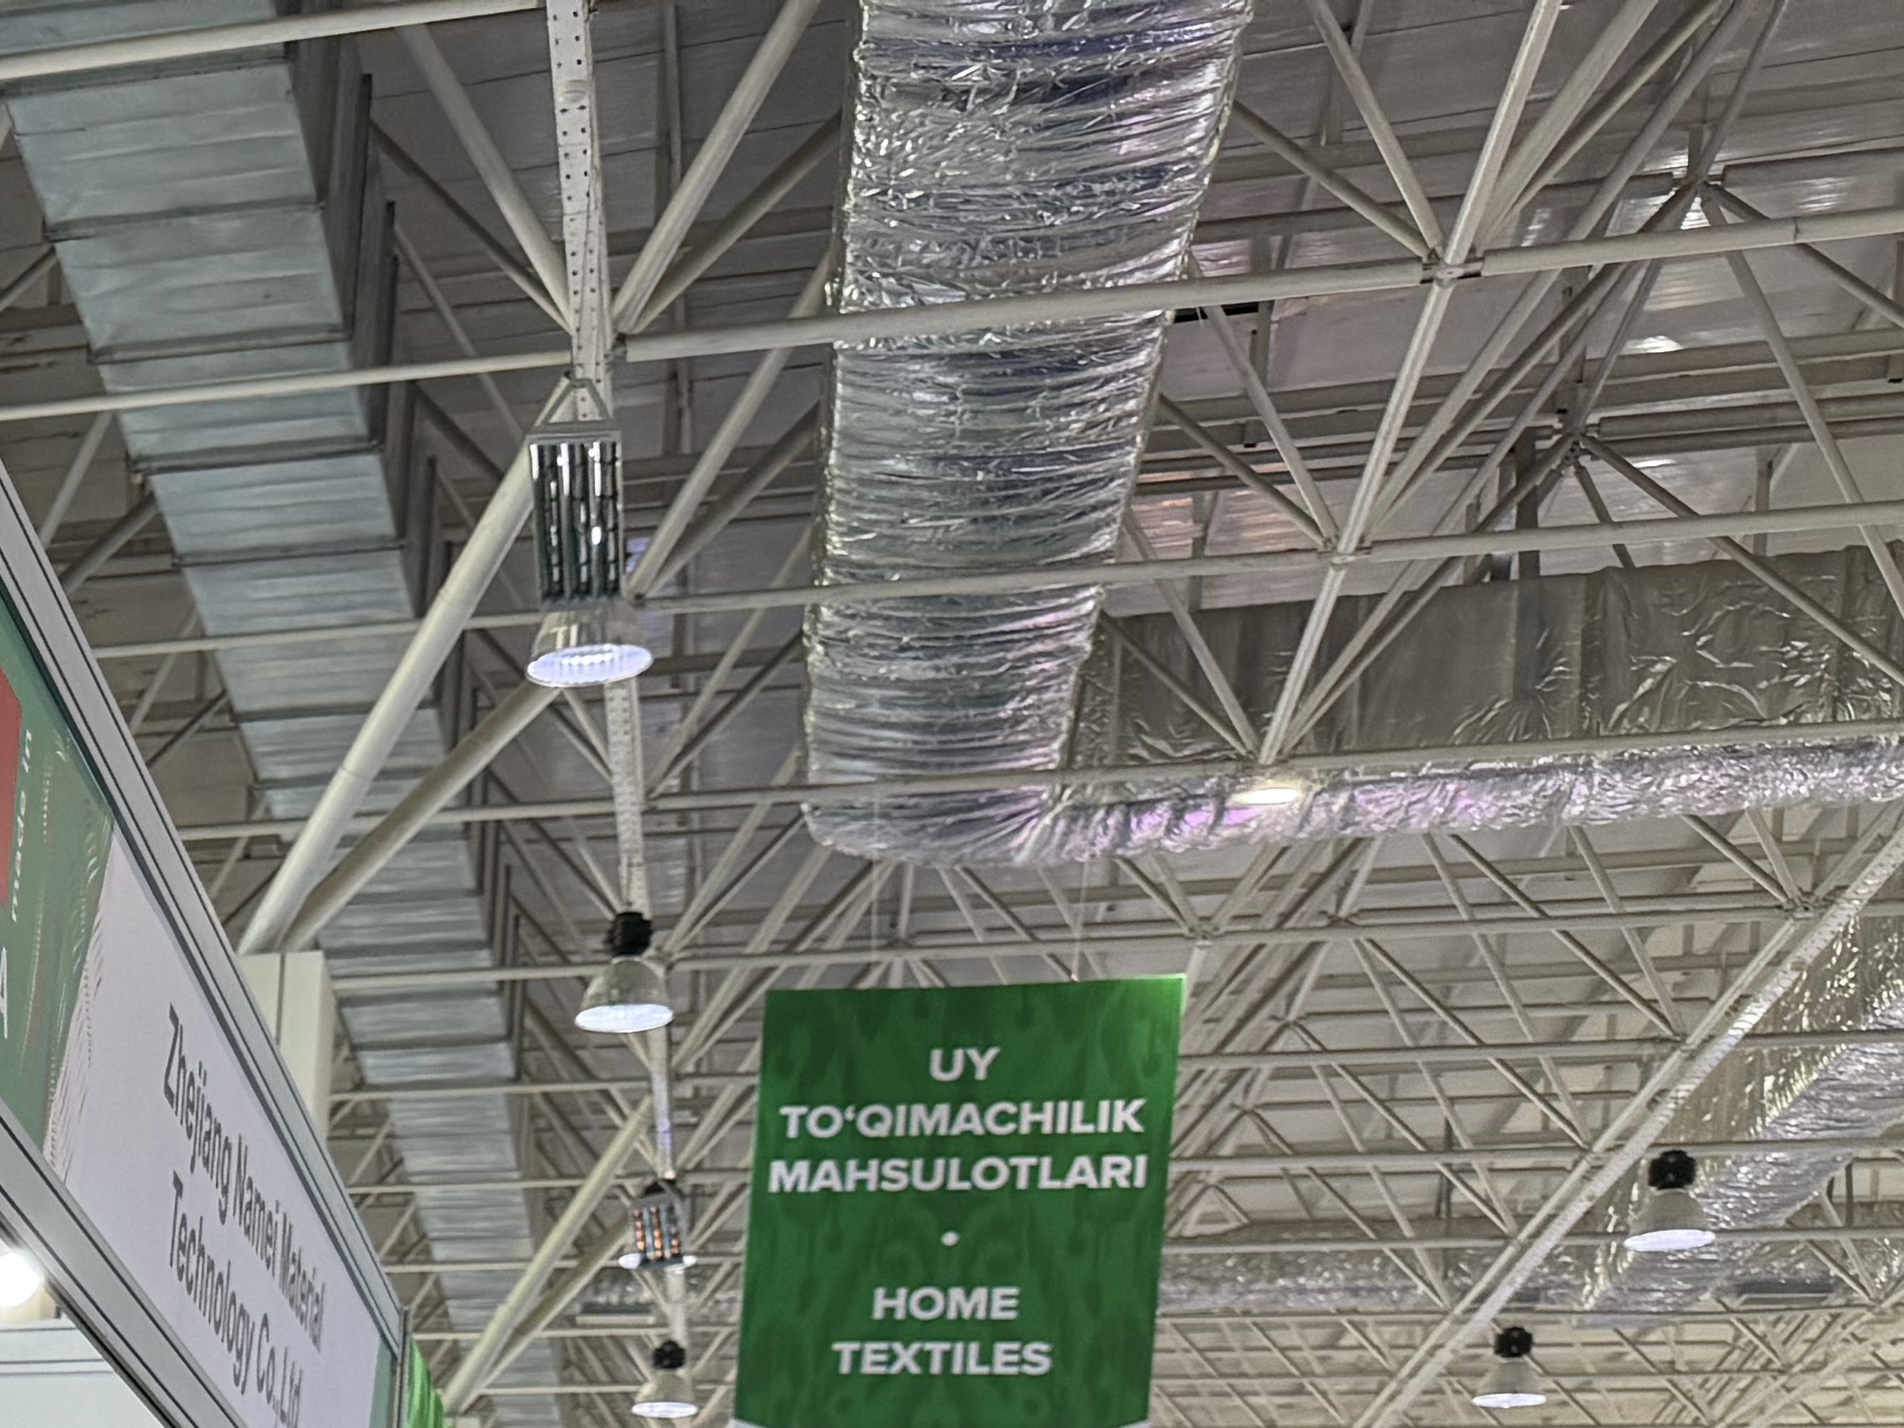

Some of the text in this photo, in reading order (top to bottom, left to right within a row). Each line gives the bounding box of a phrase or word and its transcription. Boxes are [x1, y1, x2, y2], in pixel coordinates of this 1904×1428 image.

[929, 1046, 1001, 1081] UY
[164, 1002, 326, 1353] Zhejiang Namei Material
[768, 1154, 1147, 1193] MAHSULOTLARI
[170, 1169, 255, 1395] Technology
[872, 1286, 1019, 1320] HOME
[833, 1341, 1053, 1375] TEXTILES
